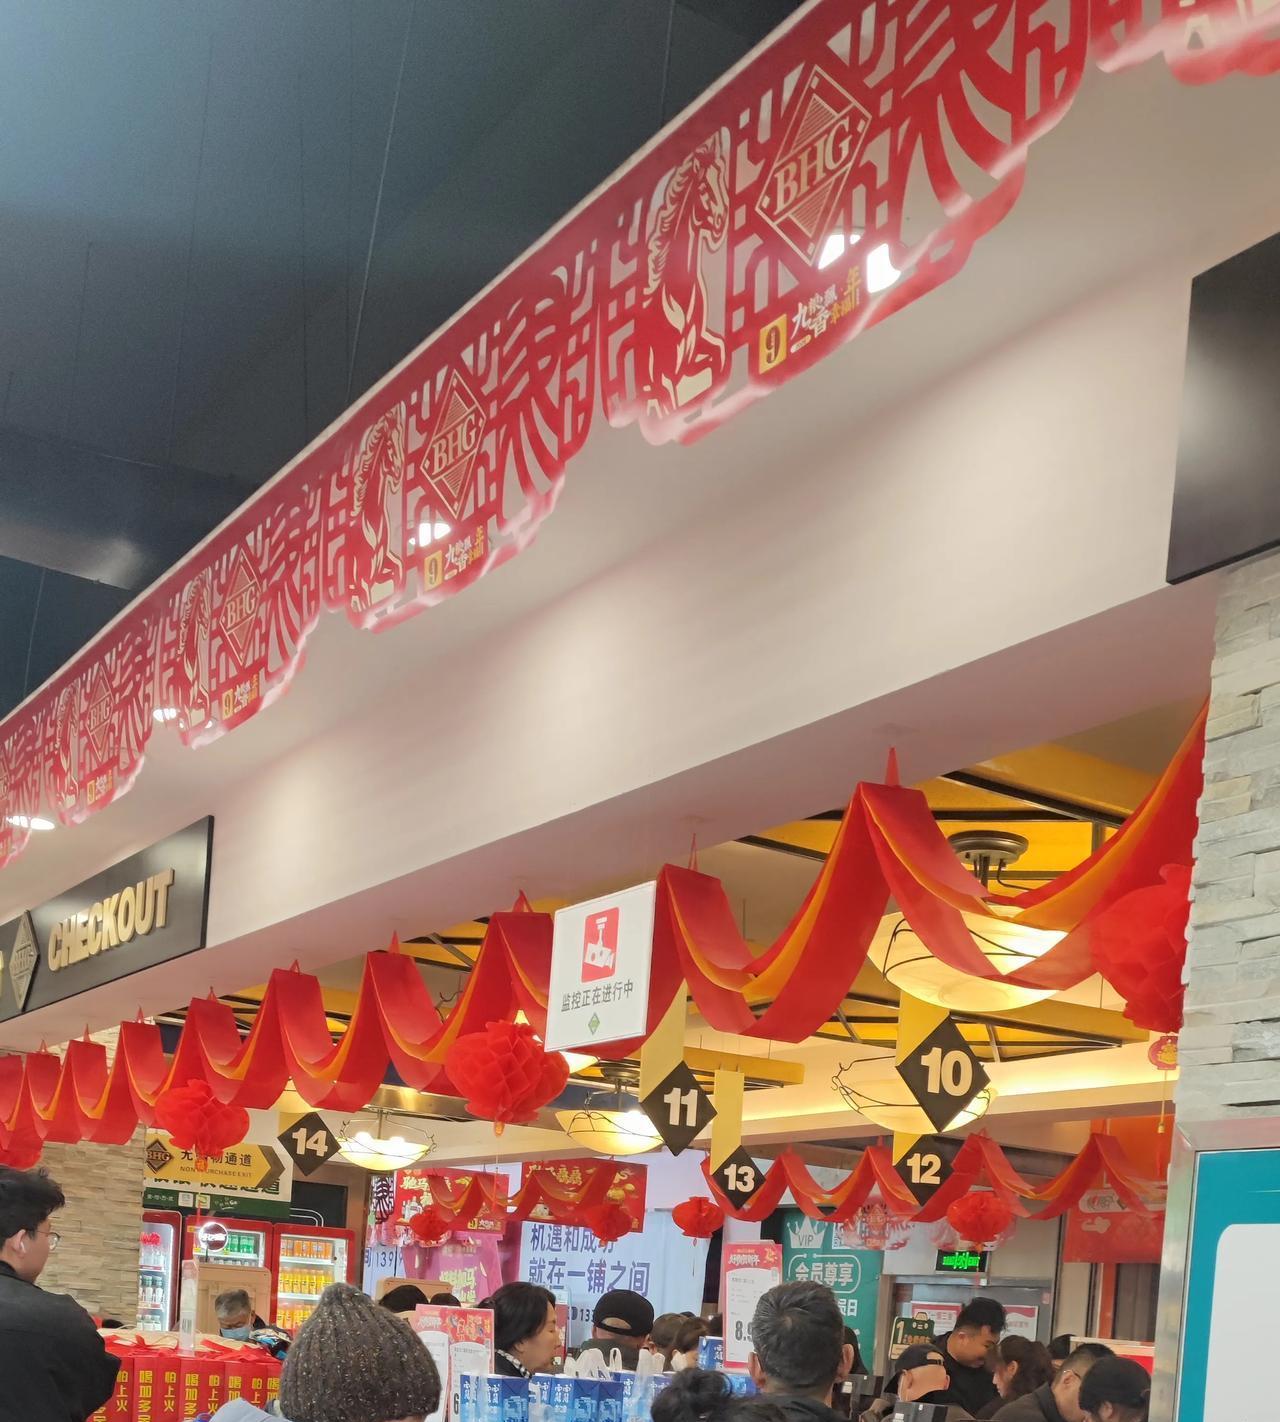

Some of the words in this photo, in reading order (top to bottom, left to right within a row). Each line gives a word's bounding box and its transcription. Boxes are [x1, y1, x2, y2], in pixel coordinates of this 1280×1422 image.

[774, 114, 852, 215] BHG
[432, 416, 476, 475] BHG
[226, 585, 257, 628] BHG
[89, 700, 110, 726] BHG
[48, 867, 175, 971] CHECKOUT
[561, 978, 634, 1013] 监控正在进行中
[920, 1047, 973, 1097] 10
[664, 1087, 698, 1127] 11
[292, 1127, 328, 1157] 14
[723, 1166, 755, 1193] 13
[906, 1152, 942, 1185] 12
[798, 1234, 814, 1247] VIP
[795, 1262, 853, 1287] 会员尊享
[117, 1370, 128, 1412] 怕上火
[164, 1371, 176, 1412] 怕上火
[184, 1373, 199, 1421] 喝加多
